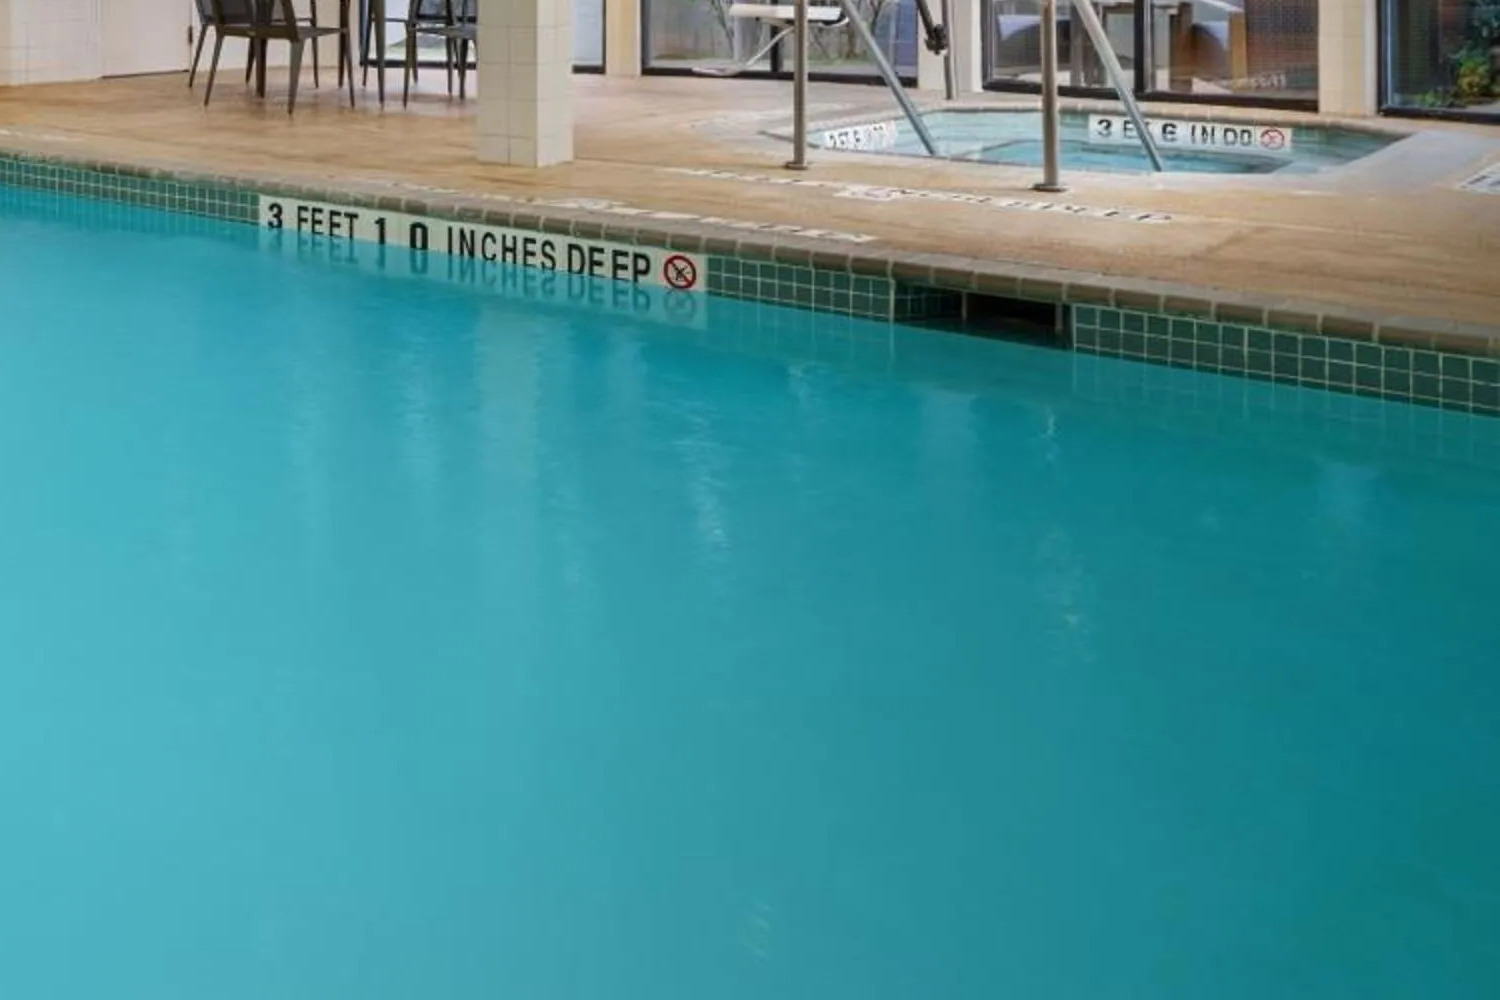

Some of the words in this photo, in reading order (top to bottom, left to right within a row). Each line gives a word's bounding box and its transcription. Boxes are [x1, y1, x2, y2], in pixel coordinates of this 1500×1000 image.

[267, 203, 283, 229] 3
[297, 205, 359, 240] FEET
[447, 226, 556, 272] INCHES
[567, 243, 650, 284] DEEP
